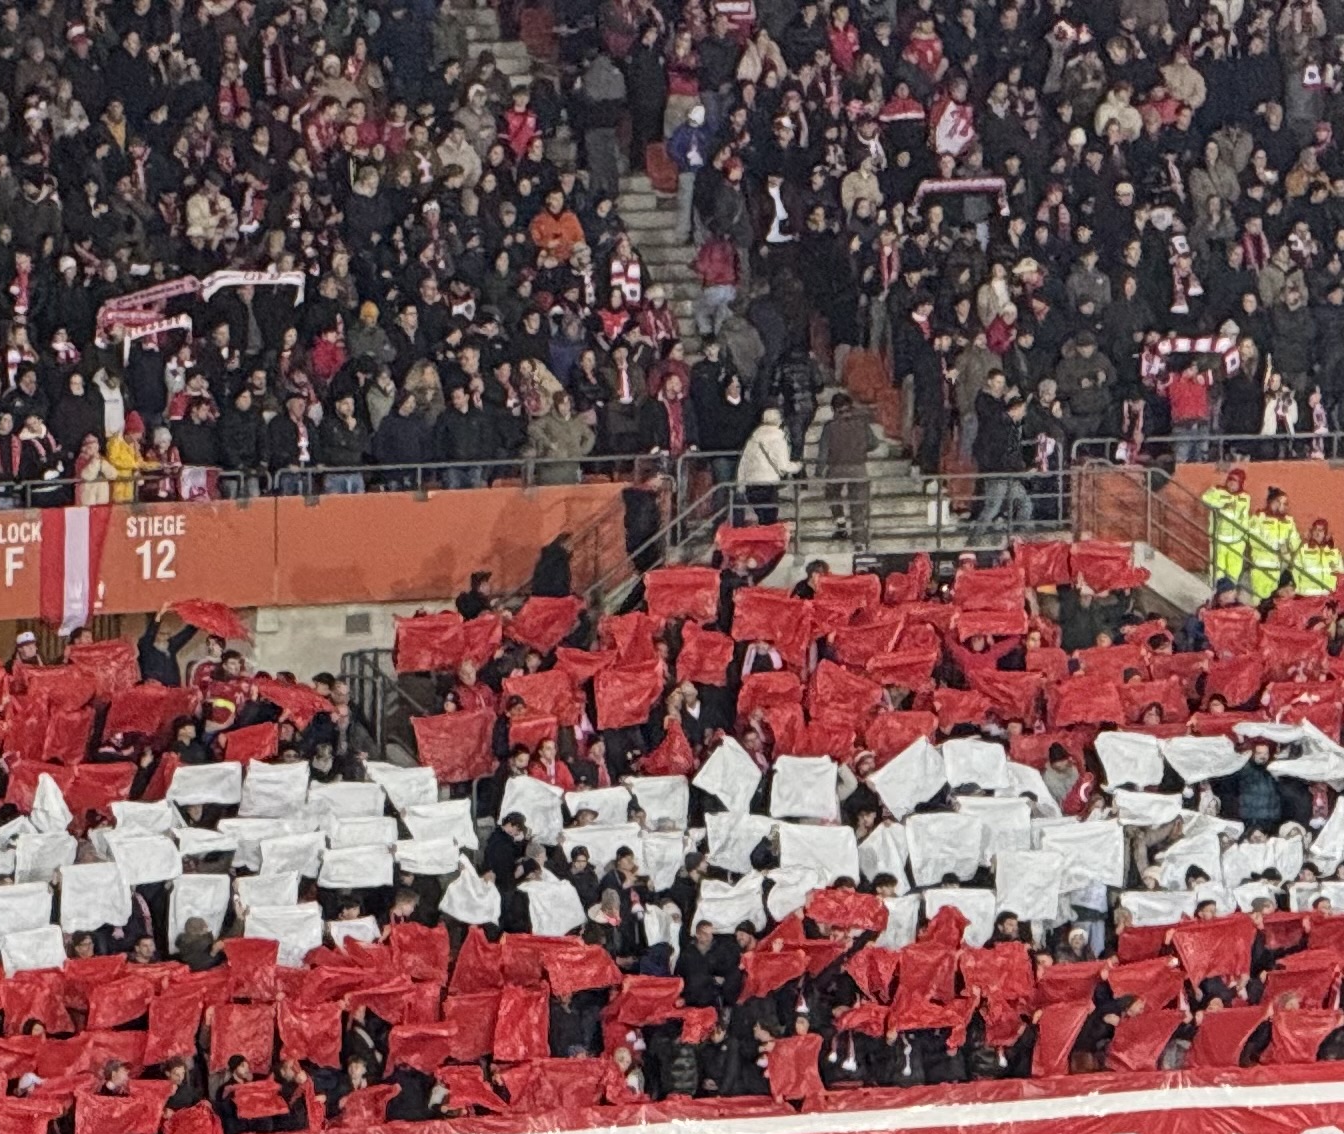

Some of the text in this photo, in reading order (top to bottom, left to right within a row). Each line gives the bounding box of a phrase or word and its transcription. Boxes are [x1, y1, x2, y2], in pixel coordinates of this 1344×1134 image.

[126, 514, 186, 537] STIEGE
[5, 547, 25, 586] F
[135, 540, 177, 579] 12
